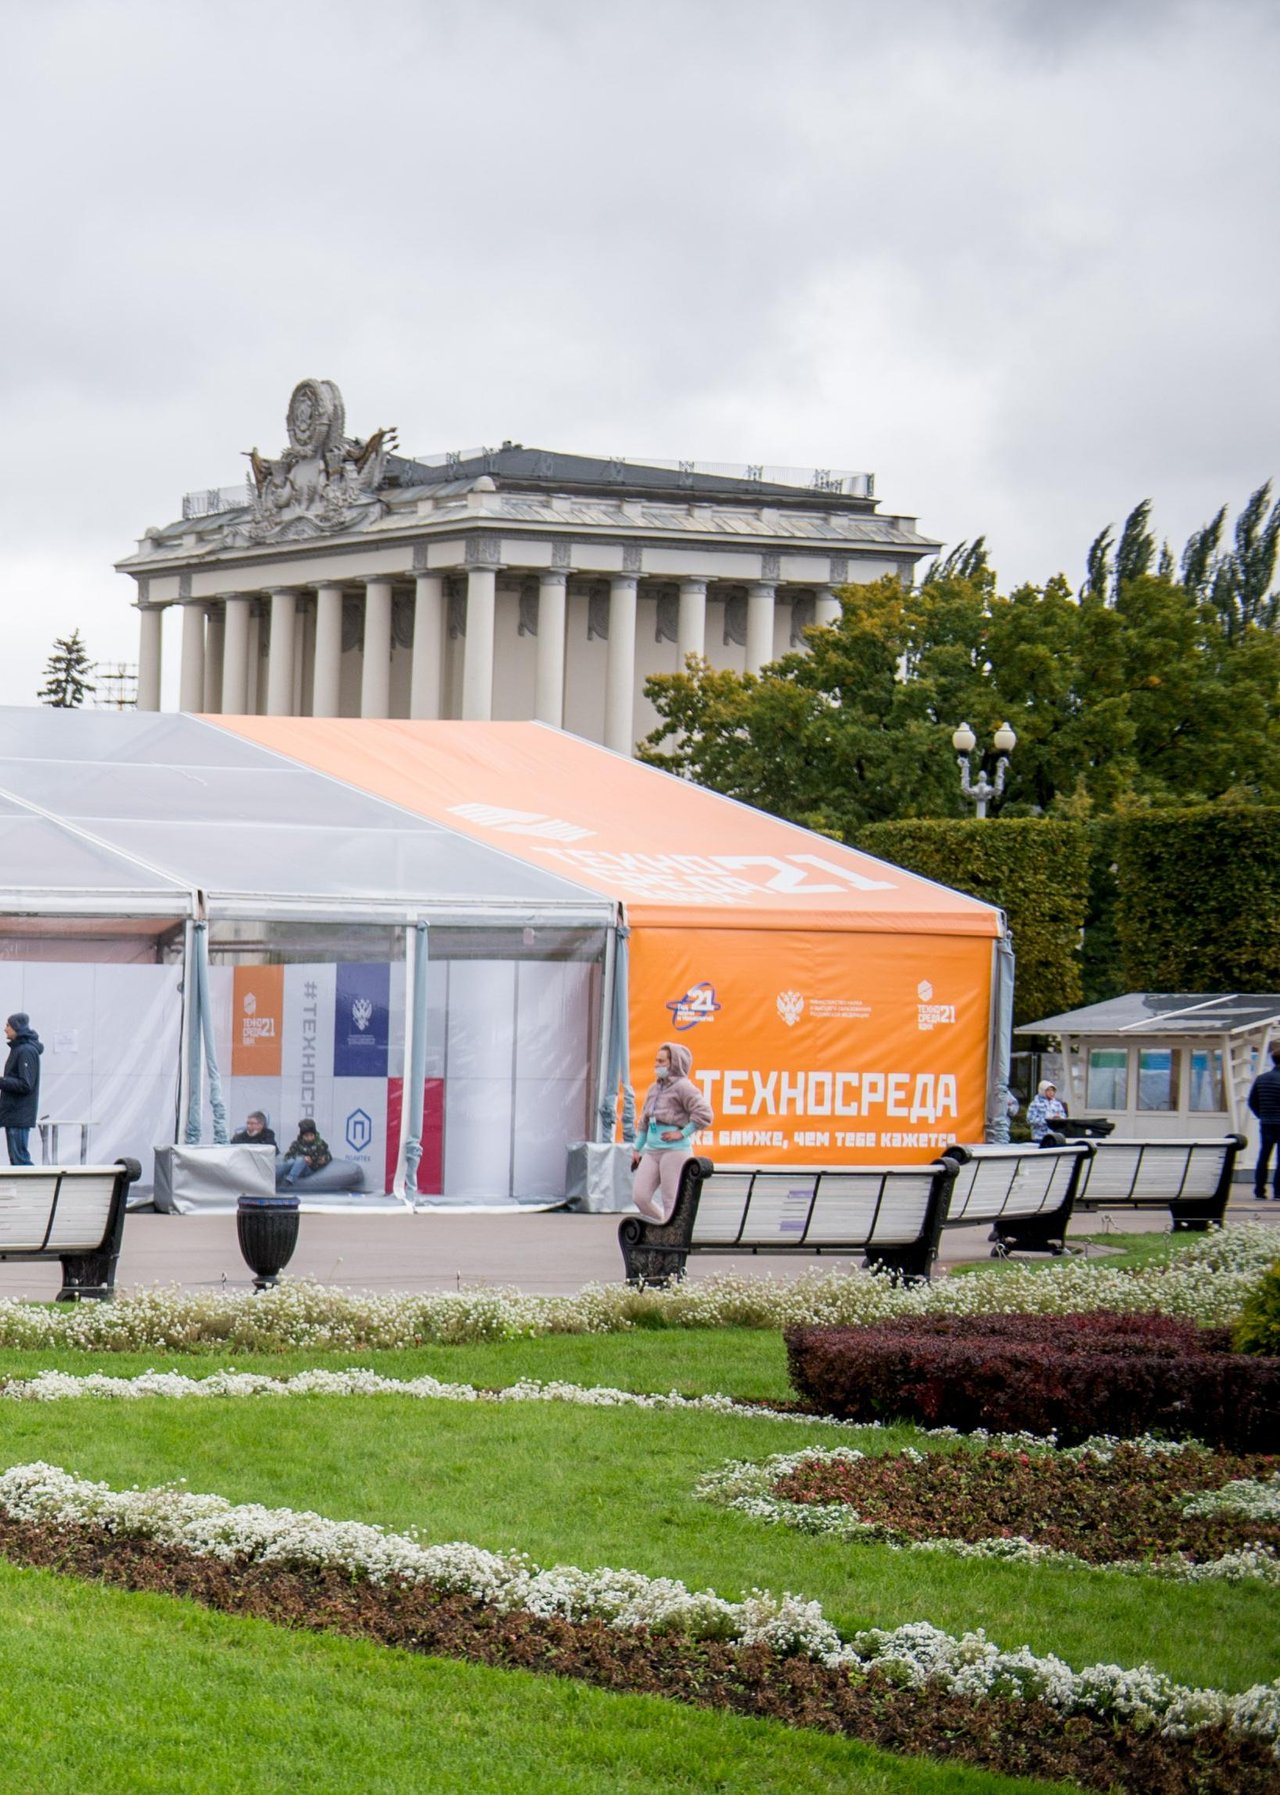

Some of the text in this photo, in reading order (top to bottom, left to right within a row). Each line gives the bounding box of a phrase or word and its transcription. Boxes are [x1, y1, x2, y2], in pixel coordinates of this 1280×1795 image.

[707, 854, 899, 894] 21
[940, 1004, 956, 1023] 21
[301, 981, 317, 1120] #ТЕХНОСР
[695, 1070, 957, 1124] ТЕХНОСРЕДА
